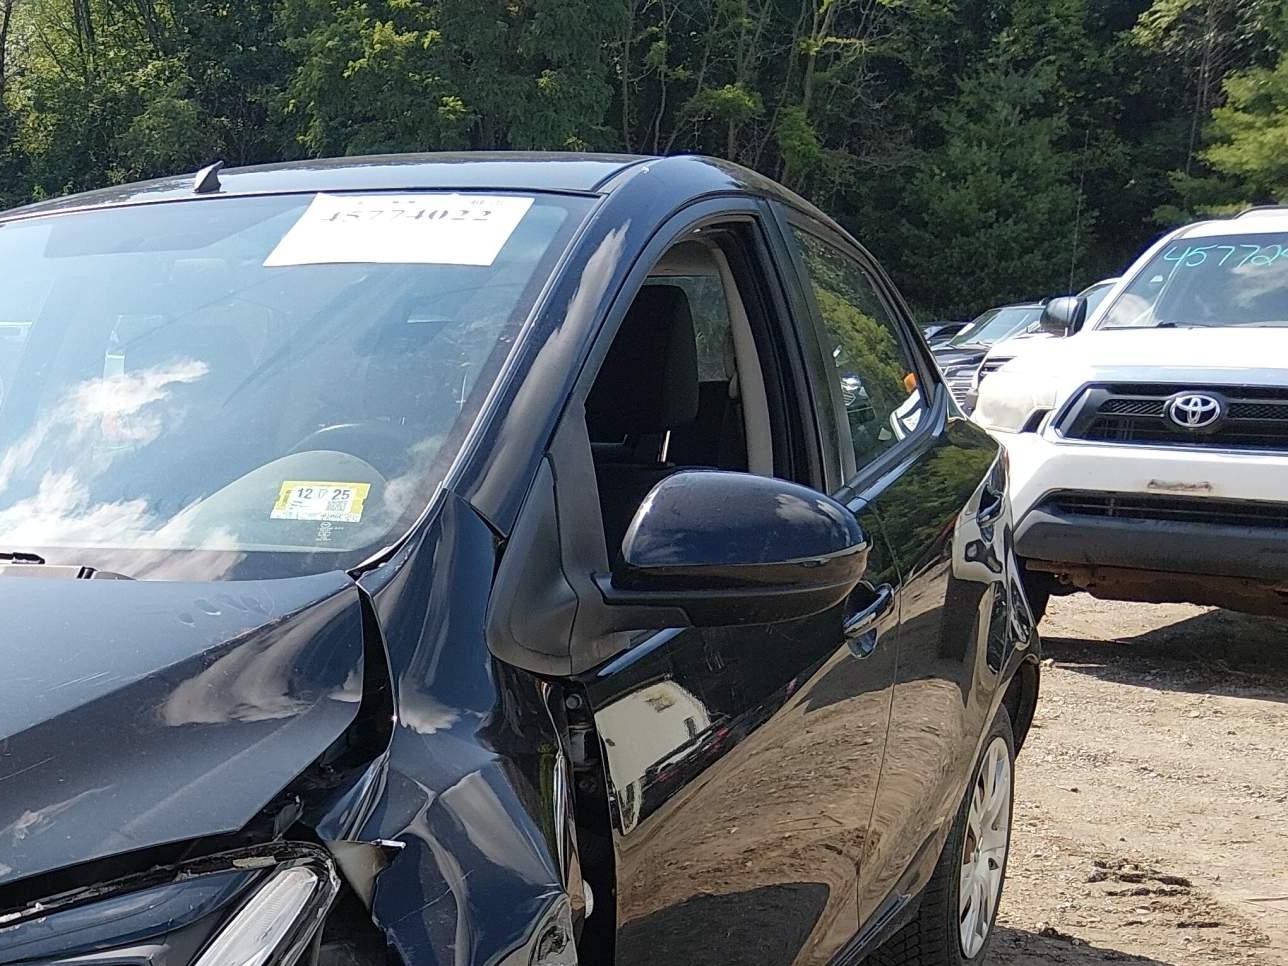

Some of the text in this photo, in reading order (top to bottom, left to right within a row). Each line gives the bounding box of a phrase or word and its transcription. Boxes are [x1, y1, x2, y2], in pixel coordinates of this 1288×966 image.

[1163, 244, 1288, 273] 45772
[297, 488, 312, 499] 12
[331, 489, 350, 500] 25
